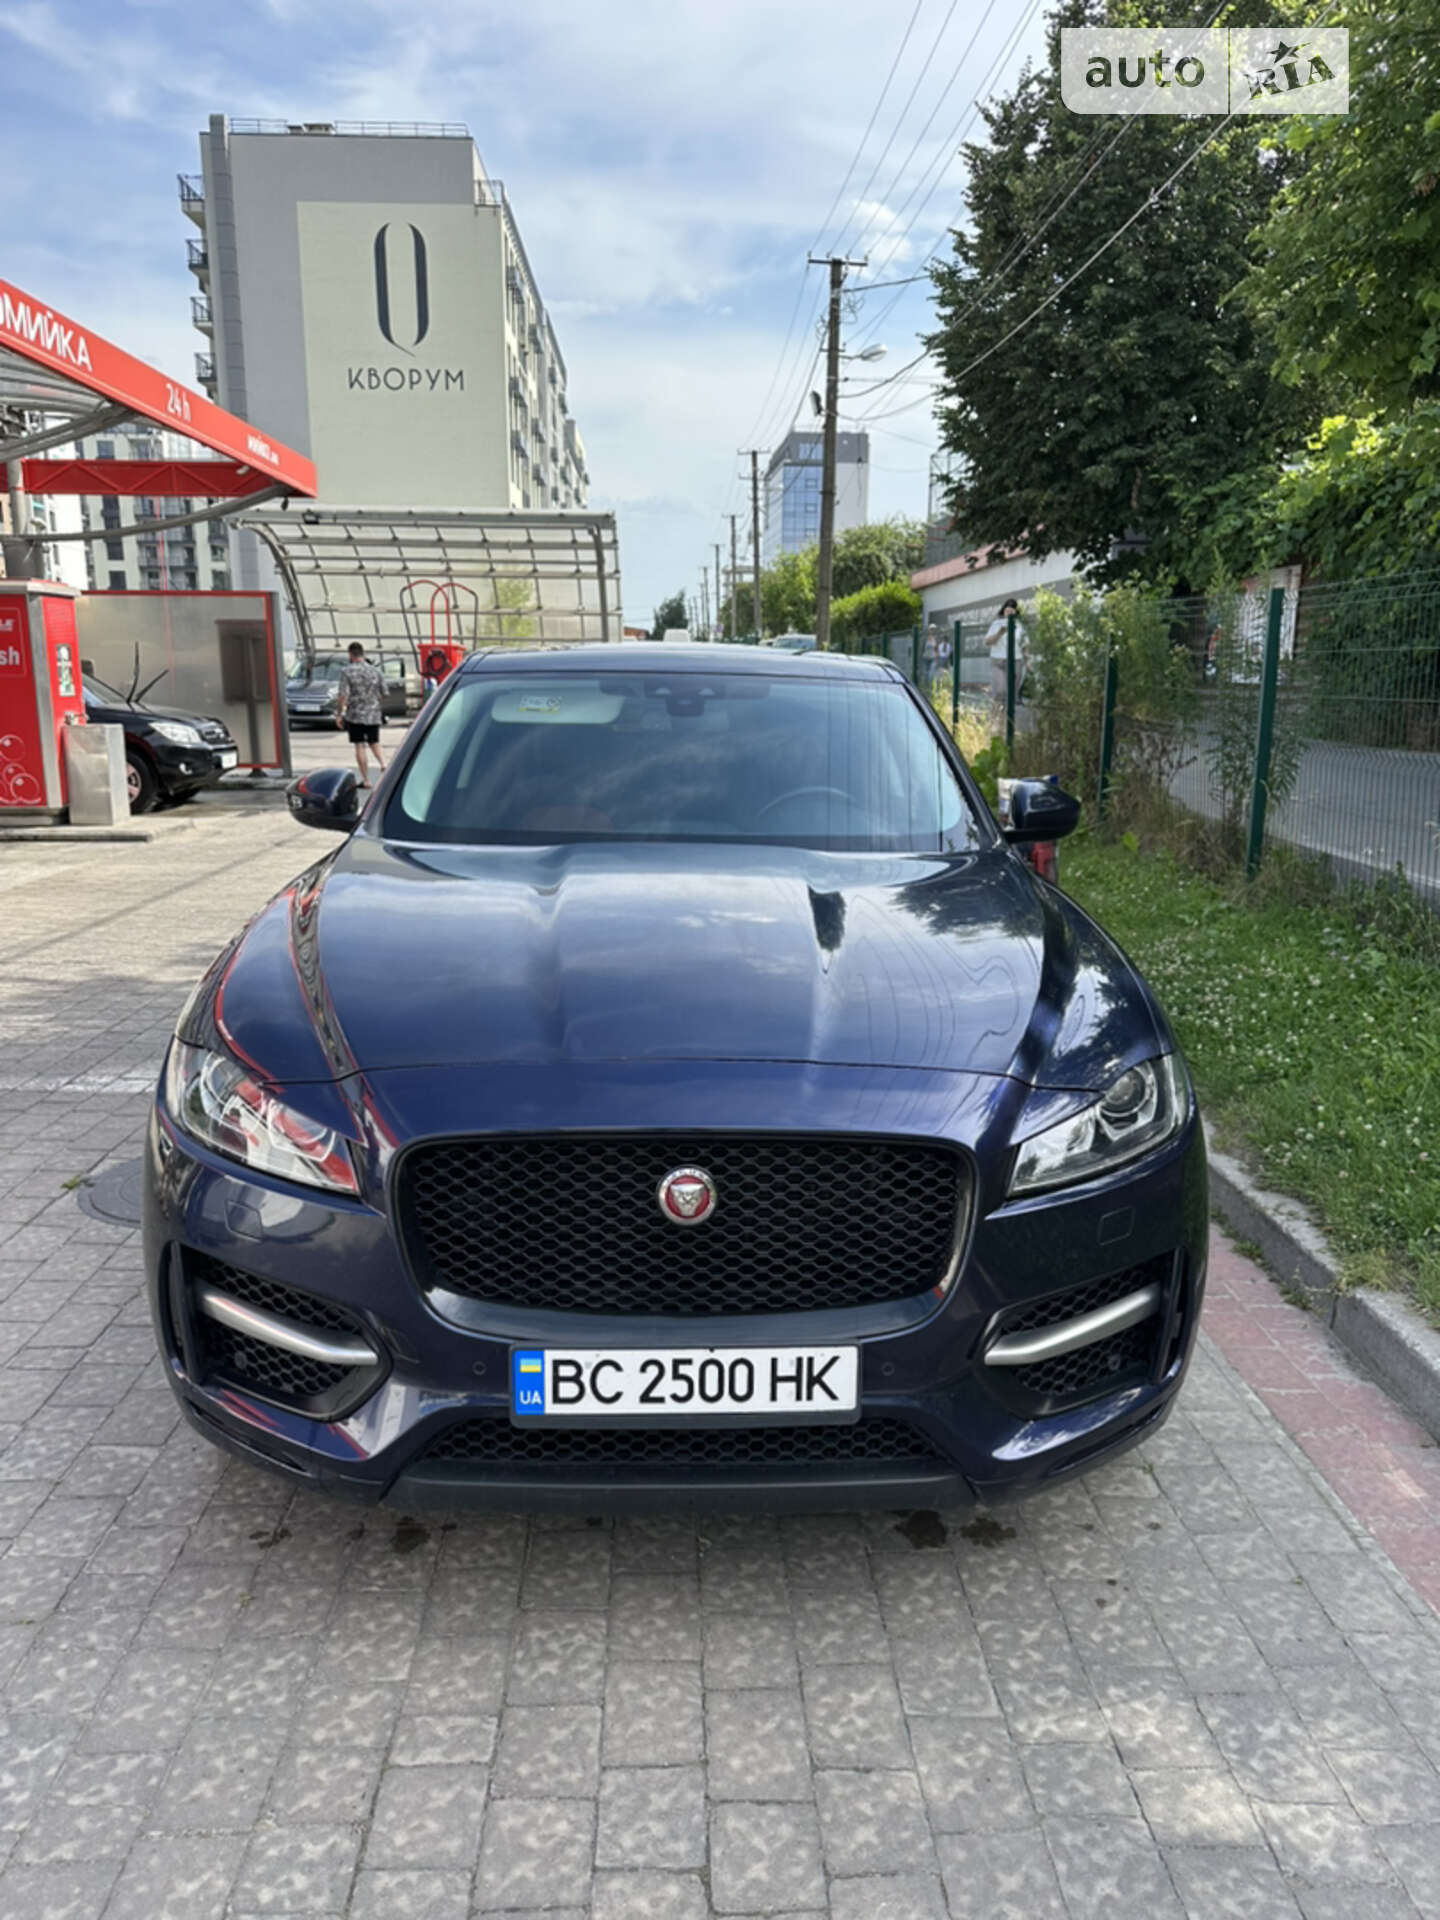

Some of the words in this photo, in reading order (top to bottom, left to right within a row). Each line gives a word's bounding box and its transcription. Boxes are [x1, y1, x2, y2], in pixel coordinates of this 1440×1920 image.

[348, 366, 465, 391] КВОРУМ
[551, 1358, 624, 1405] BC
[639, 1357, 755, 1404] 2500
[769, 1355, 840, 1403] HK
[519, 1390, 543, 1405] UA
